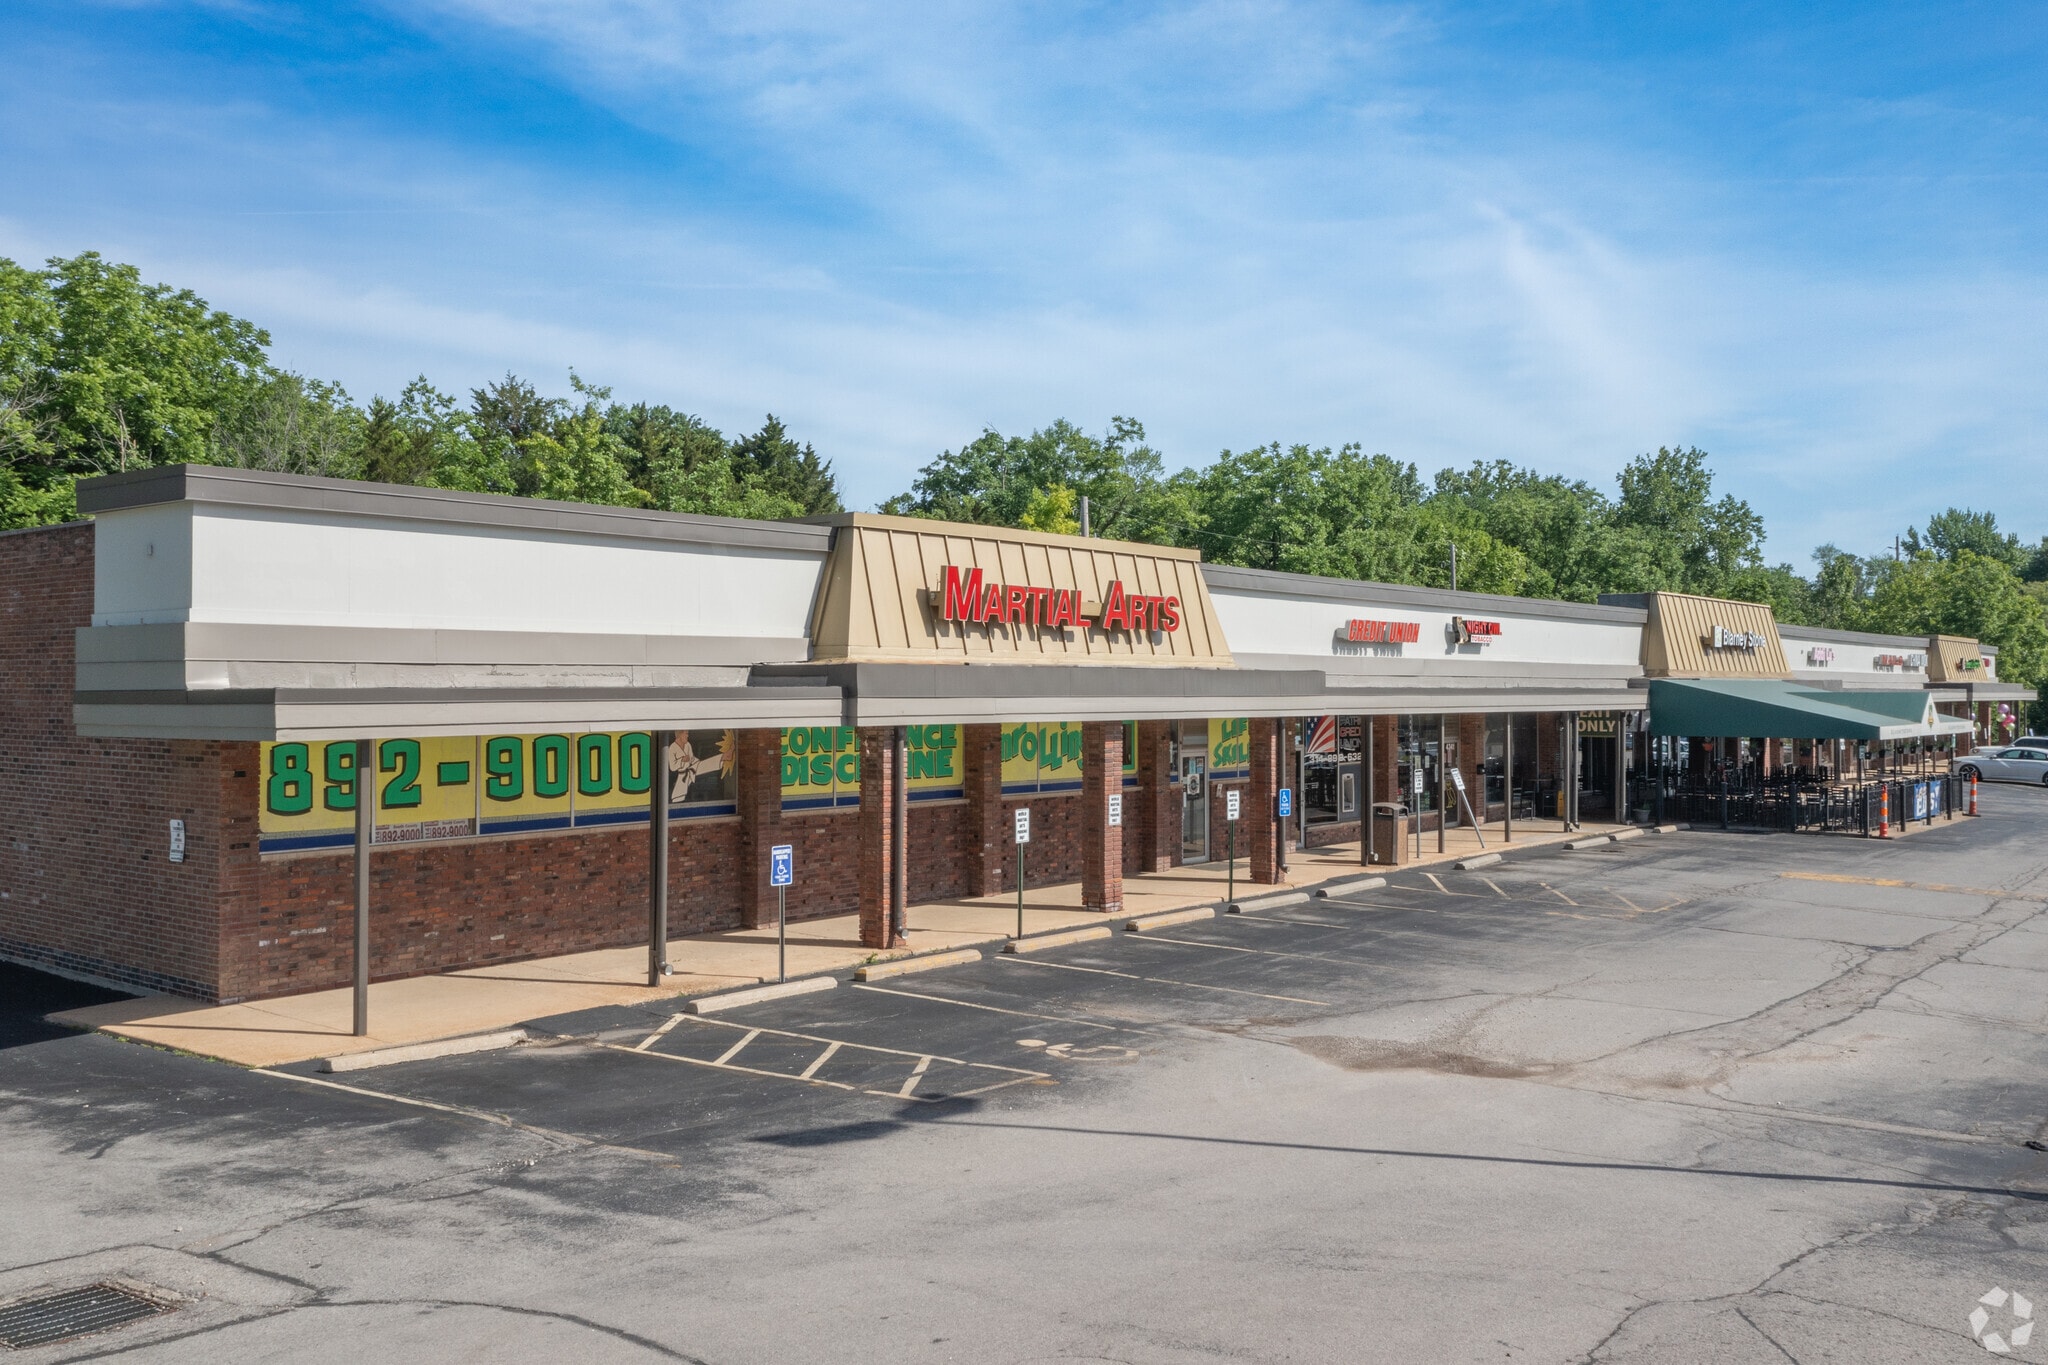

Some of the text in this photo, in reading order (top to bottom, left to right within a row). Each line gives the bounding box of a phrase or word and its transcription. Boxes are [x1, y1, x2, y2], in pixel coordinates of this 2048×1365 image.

[1348, 619, 1420, 643] CREDIT UNION
[1466, 620, 1487, 634] NIGHT
[1471, 635, 1493, 643] TOBACCO
[1723, 629, 1766, 650] Blarney Stone
[1340, 726, 1361, 737] CRED
[1578, 720, 1616, 732] ONLY
[267, 732, 651, 816] 892-9000
[382, 828, 420, 842] 892-9000
[432, 824, 468, 838] 892-9000
